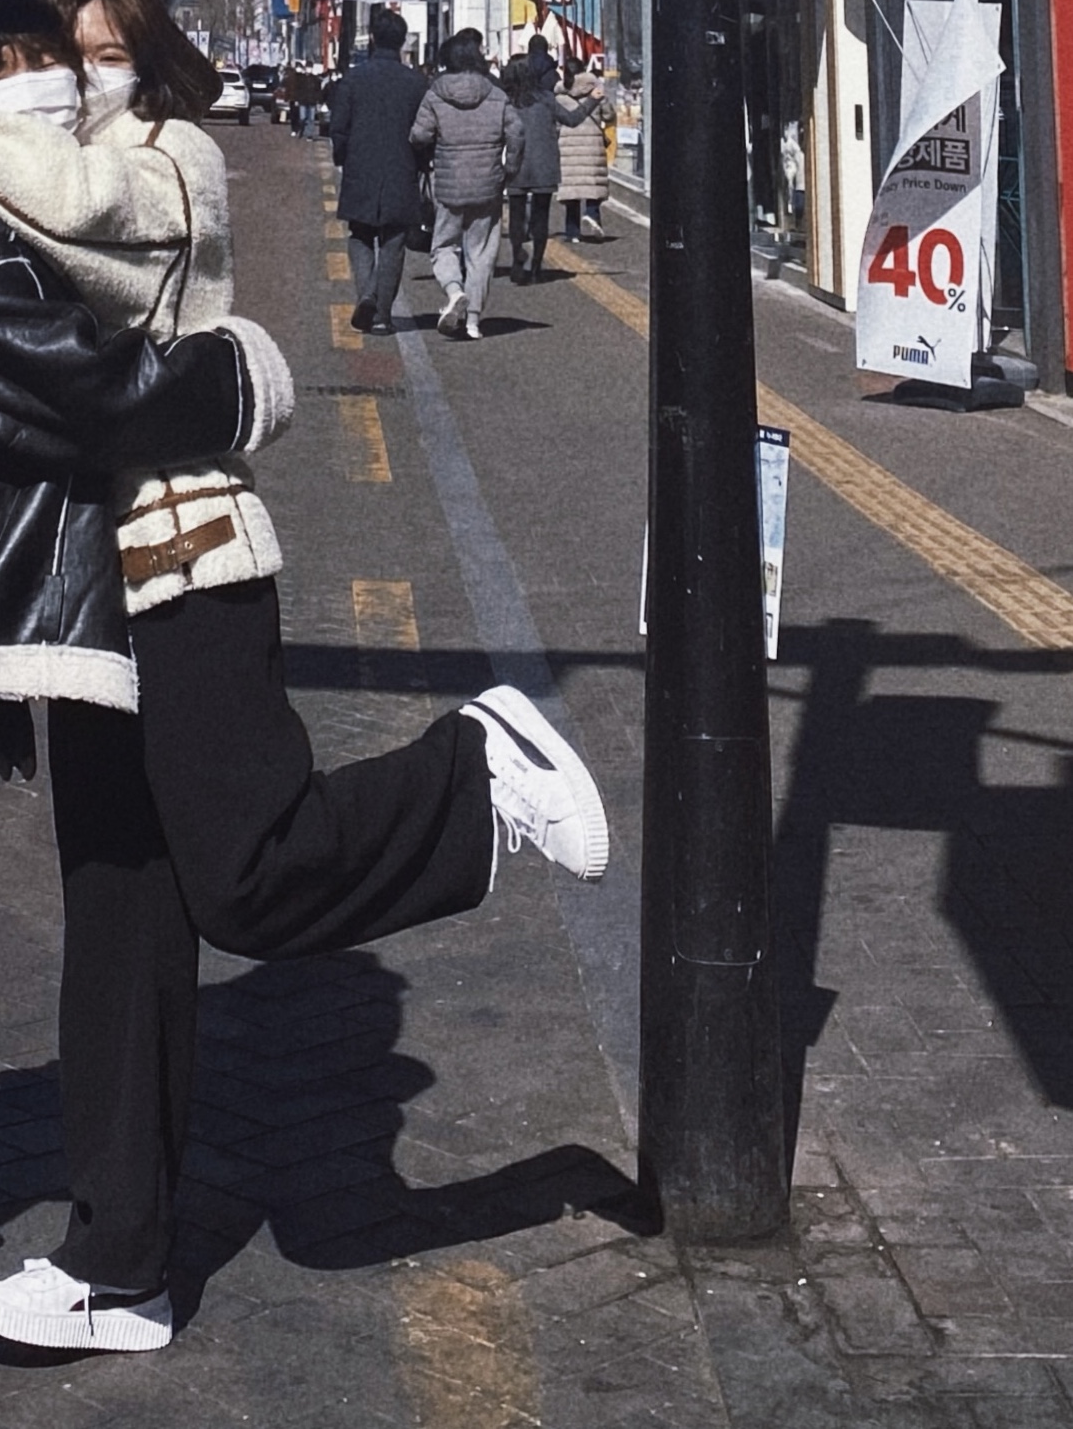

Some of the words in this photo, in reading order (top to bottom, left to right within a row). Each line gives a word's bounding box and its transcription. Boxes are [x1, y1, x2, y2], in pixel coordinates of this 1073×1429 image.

[902, 177, 933, 190] Price
[934, 179, 967, 193] Down
[893, 344, 929, 365] PUMA
